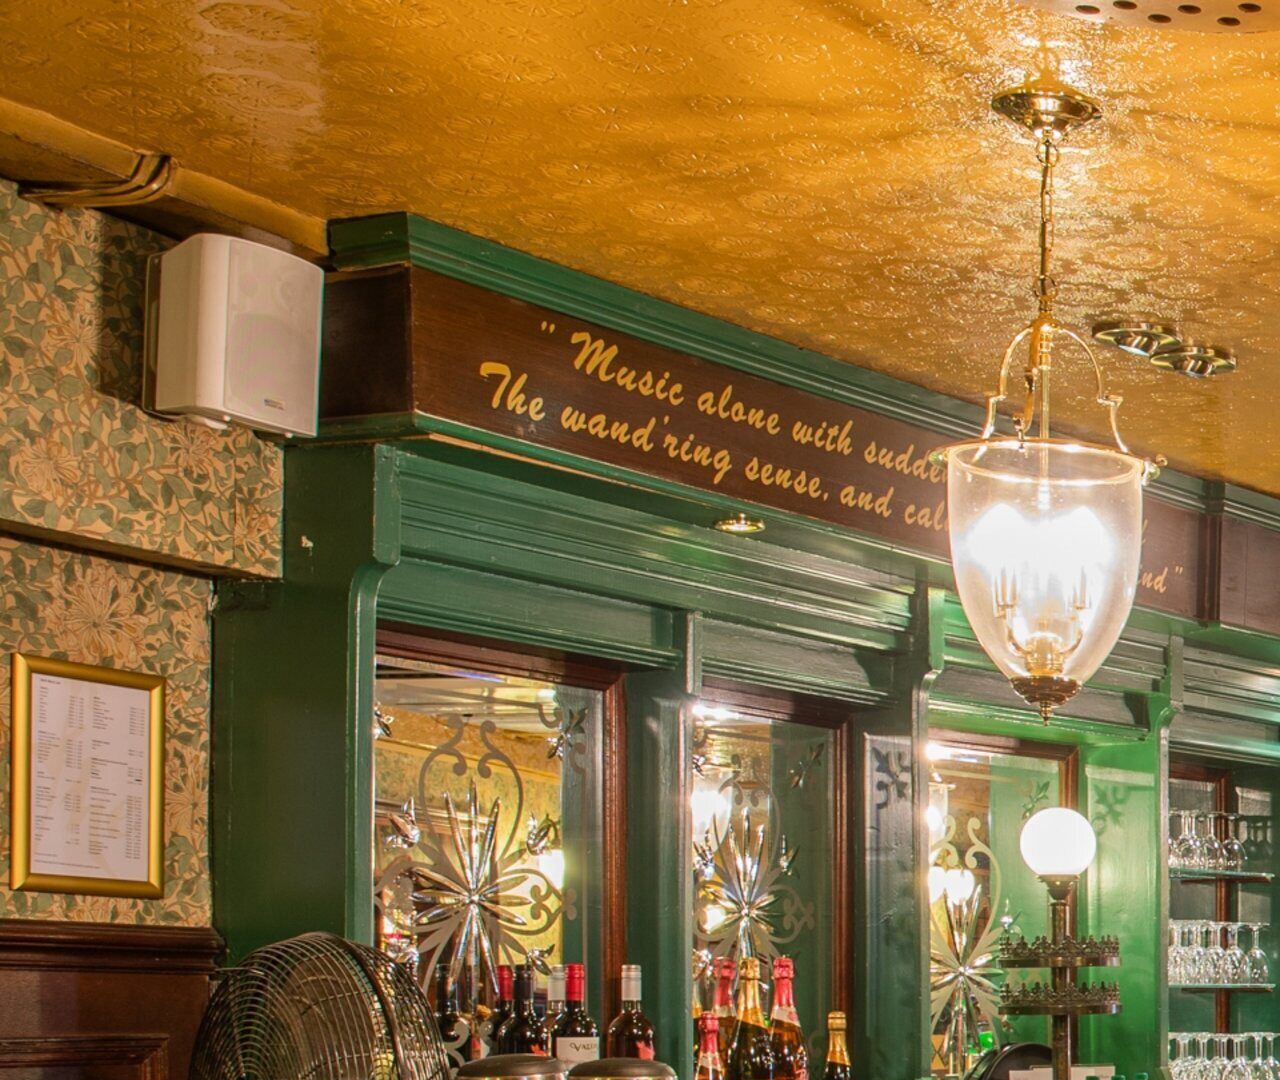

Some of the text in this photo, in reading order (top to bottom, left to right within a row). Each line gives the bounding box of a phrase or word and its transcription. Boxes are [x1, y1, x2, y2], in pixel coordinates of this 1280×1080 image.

[479, 361, 546, 422] The
[560, 405, 732, 484] wand'ring
[744, 456, 830, 501] sense,
[840, 485, 895, 519] and
[570, 331, 684, 406] Music
[697, 384, 781, 435] alone
[792, 419, 854, 456] with
